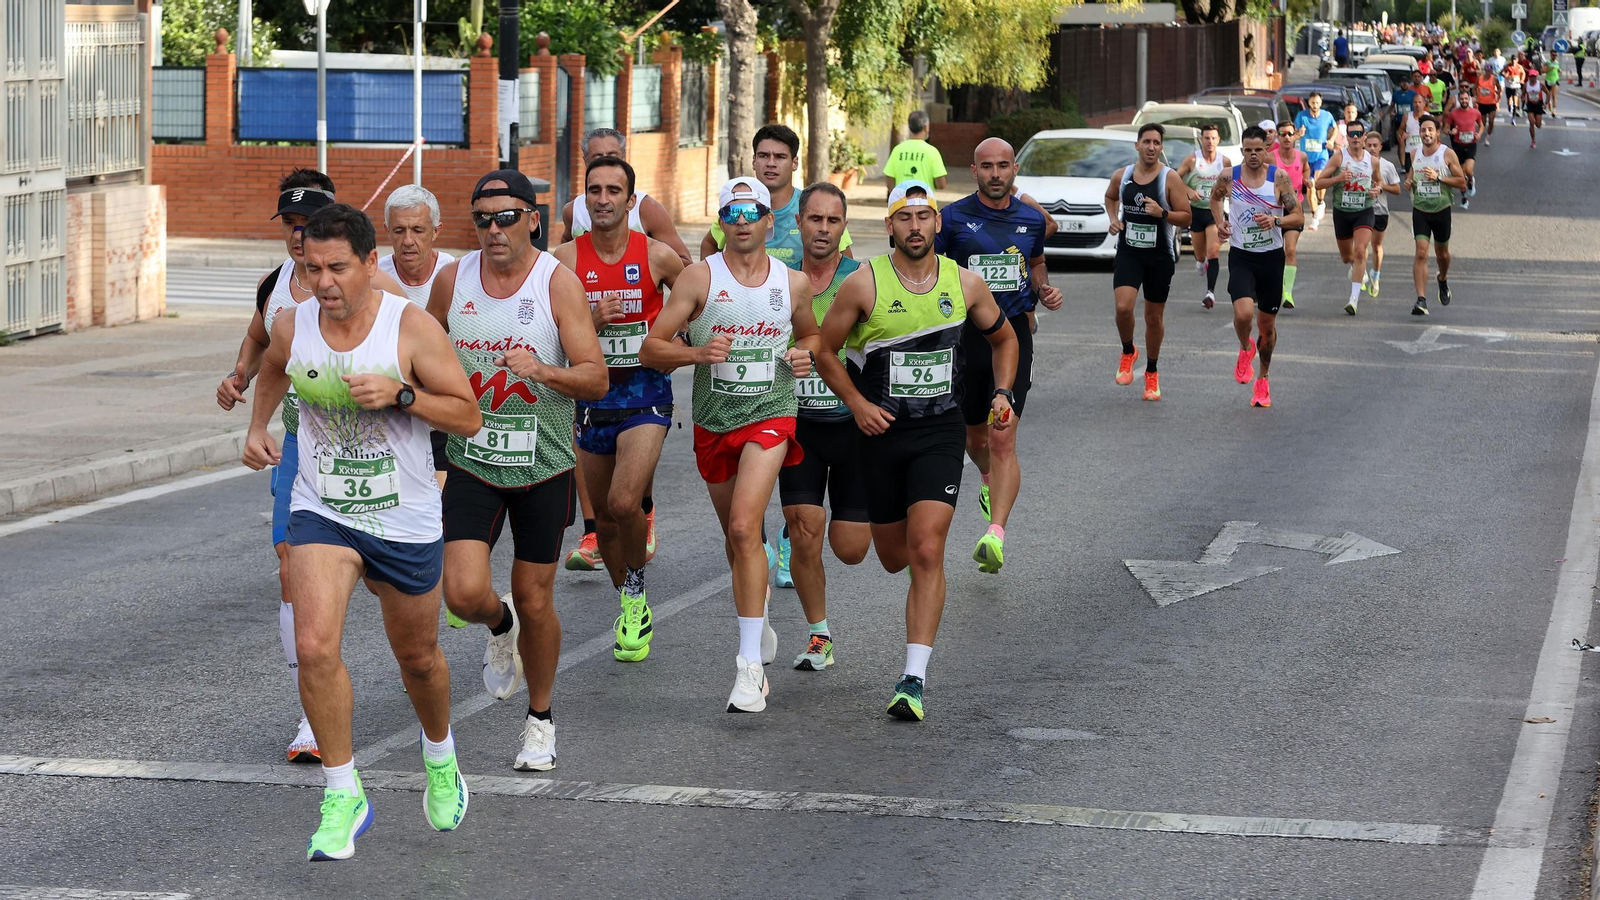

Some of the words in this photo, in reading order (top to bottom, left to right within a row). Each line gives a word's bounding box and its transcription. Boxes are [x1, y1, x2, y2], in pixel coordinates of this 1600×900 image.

[899, 152, 925, 161] STAFF
[1015, 225, 1028, 234] NB
[1134, 231, 1146, 240] 10
[1251, 232, 1264, 242] 24
[981, 266, 1008, 280] 122
[603, 288, 643, 300] ATETISMO
[711, 320, 782, 338] maratón
[455, 335, 538, 354] maratón
[608, 338, 627, 354] 11
[610, 357, 640, 365] MIZUN
[736, 364, 747, 380] 9
[911, 367, 934, 383] 96
[798, 379, 827, 395] 110
[486, 430, 510, 450] 81
[343, 478, 373, 498] 36
